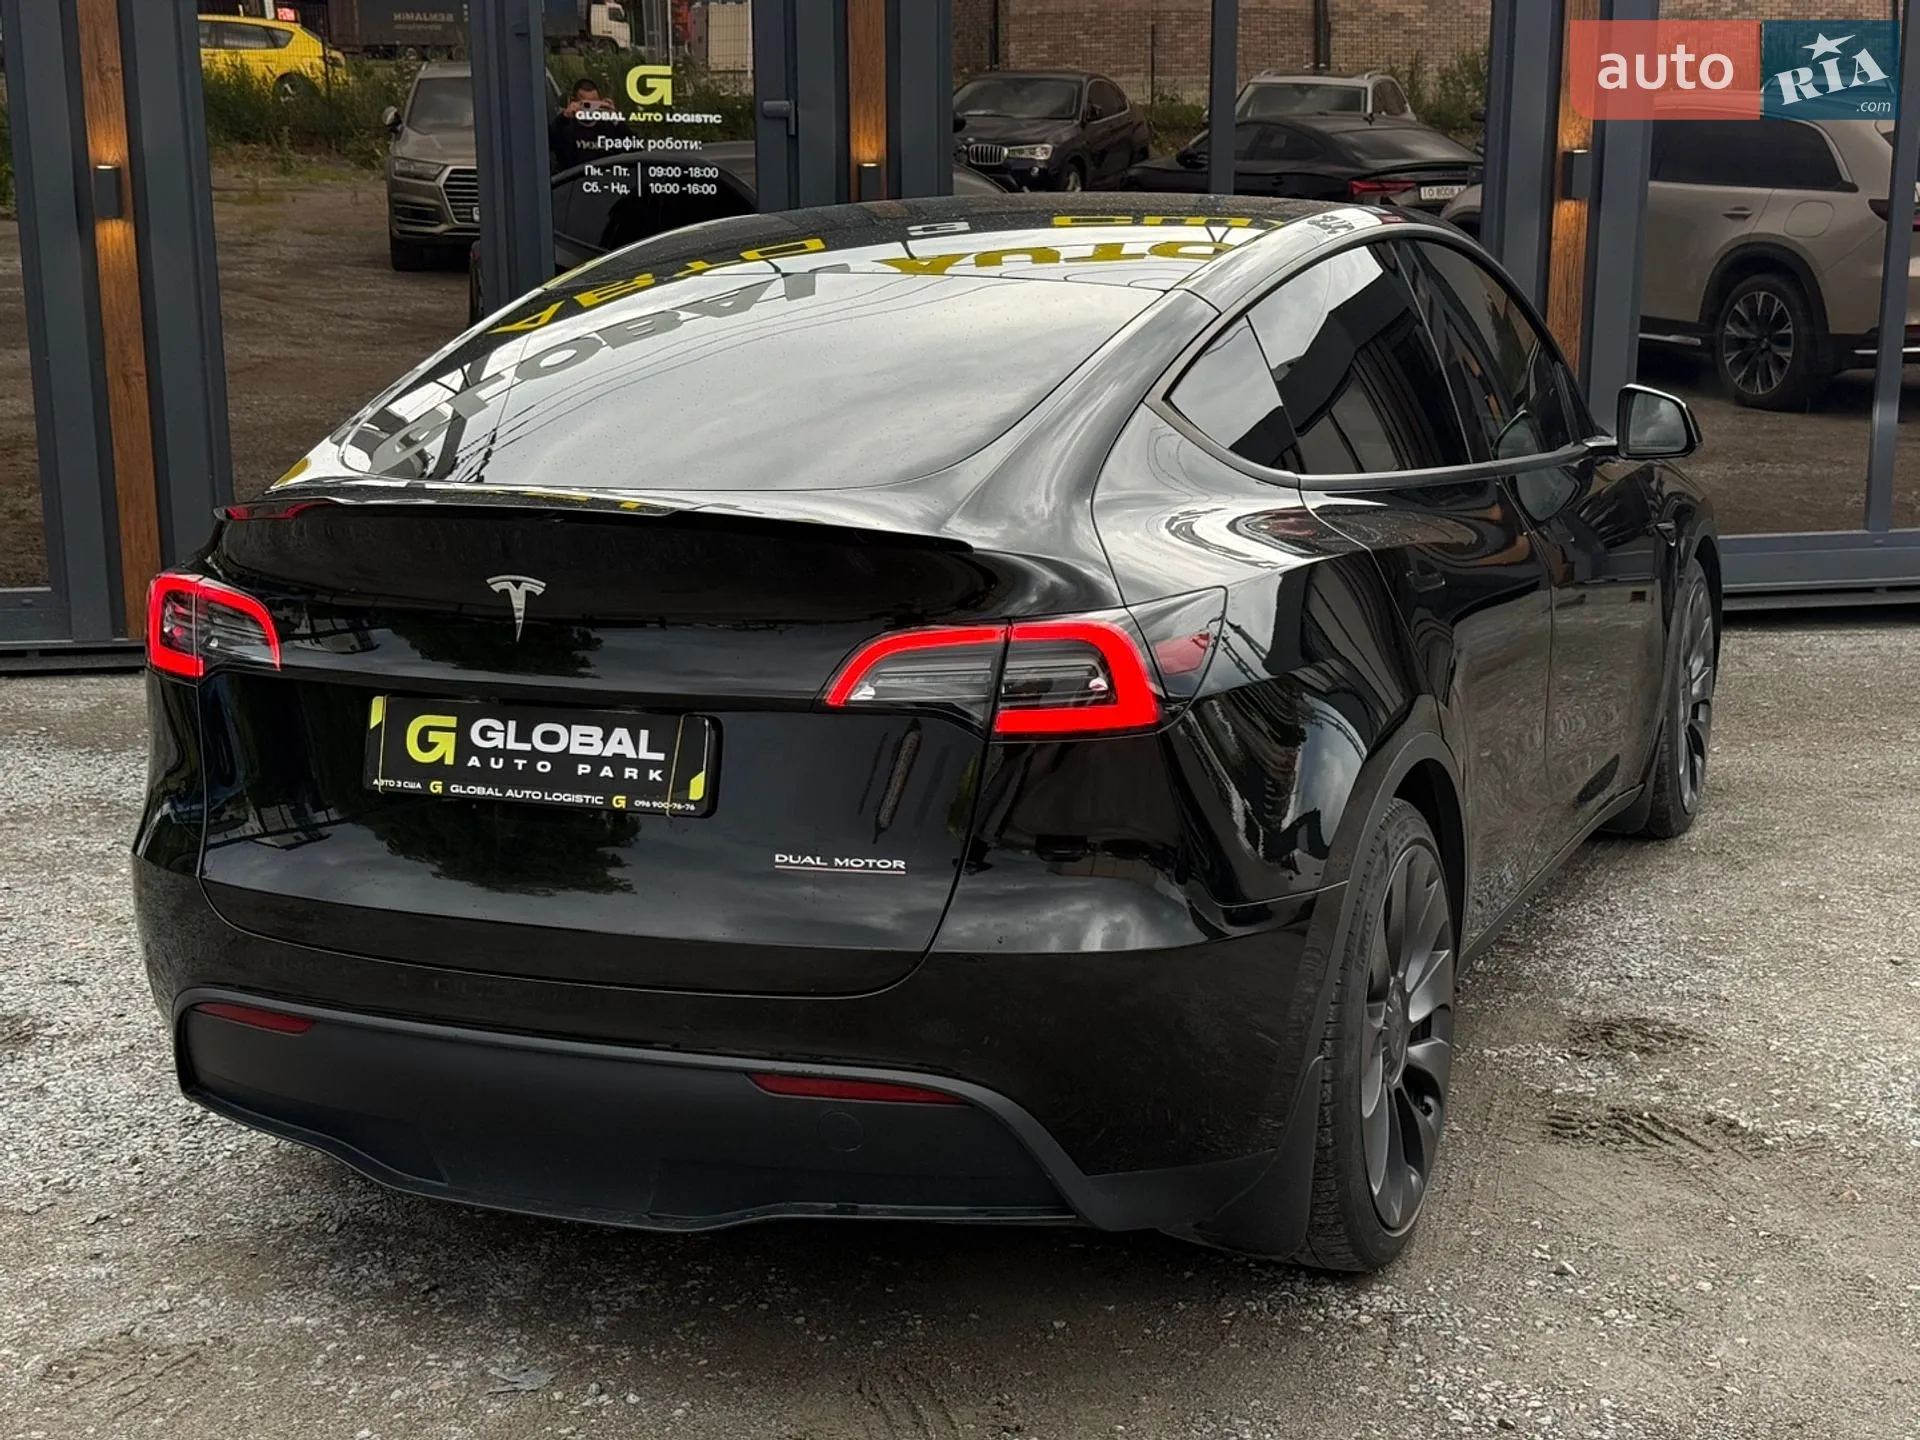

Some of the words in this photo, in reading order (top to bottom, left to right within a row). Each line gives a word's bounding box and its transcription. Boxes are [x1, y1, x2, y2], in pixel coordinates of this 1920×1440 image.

[575, 111, 626, 121] GLOBAL
[629, 112, 663, 122] AUTO
[666, 113, 723, 124] LOGISTIC
[597, 135, 645, 151] Графік
[648, 137, 703, 151] роботи:
[648, 166, 682, 178] 09:00
[649, 183, 680, 193] 10:00
[470, 718, 666, 761] GLOBAL
[467, 756, 552, 773] AUTO
[577, 763, 664, 782] PARK
[450, 784, 502, 797] GLOBAL
[505, 789, 541, 800] AUTO
[544, 792, 604, 805] LOGISTIC
[774, 853, 828, 866] DUAL
[834, 857, 906, 869] MOTOR
